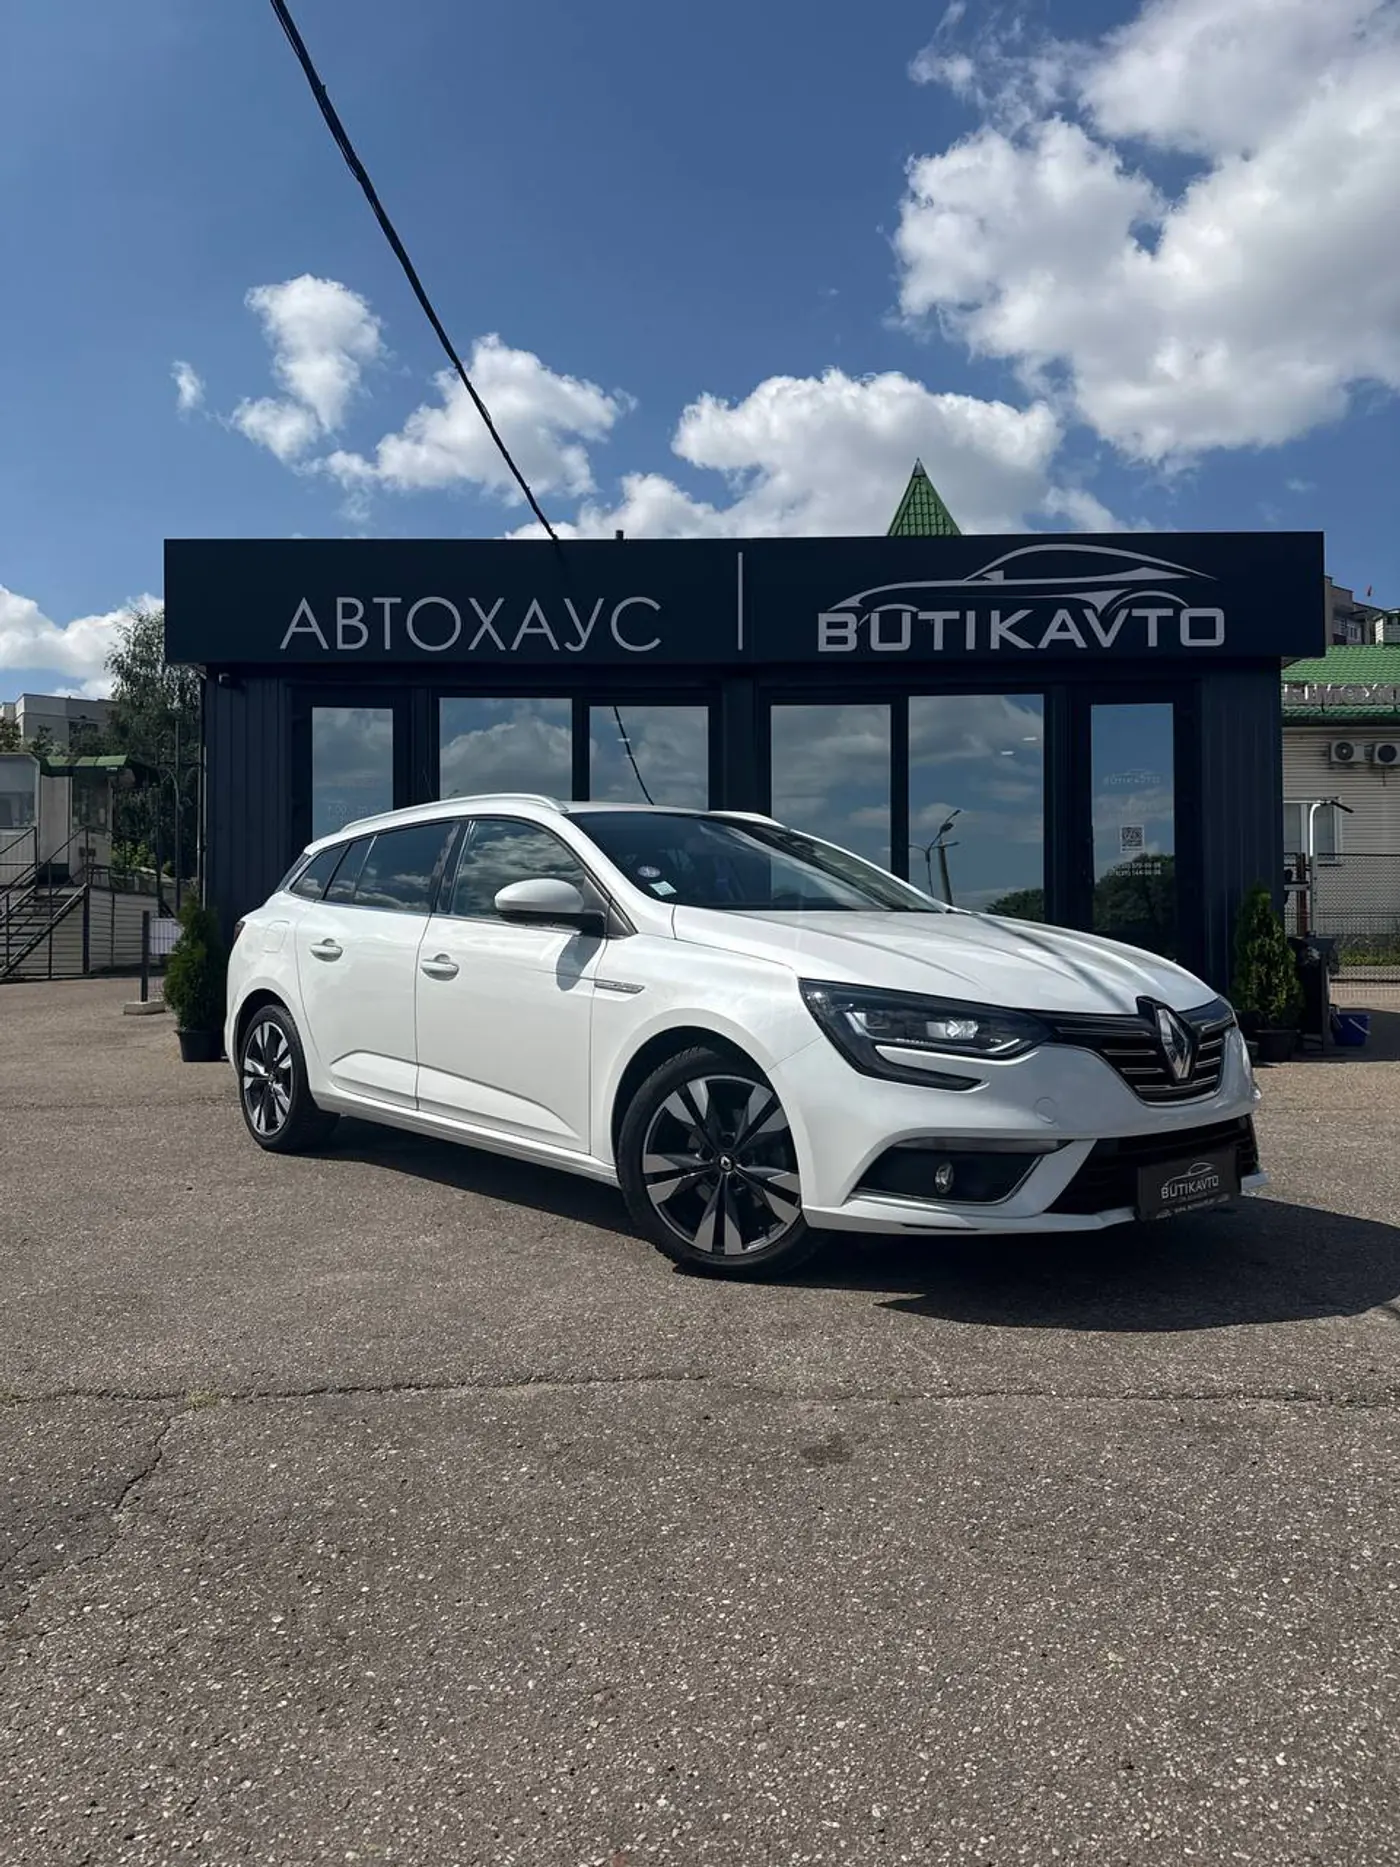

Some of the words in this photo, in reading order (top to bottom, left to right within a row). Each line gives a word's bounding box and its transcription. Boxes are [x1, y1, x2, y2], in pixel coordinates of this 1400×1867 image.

[280, 597, 661, 652] АВТОХАУС
[817, 607, 1225, 652] BUTIKAVTO
[1160, 1175, 1219, 1199] BUTIKAVTO
